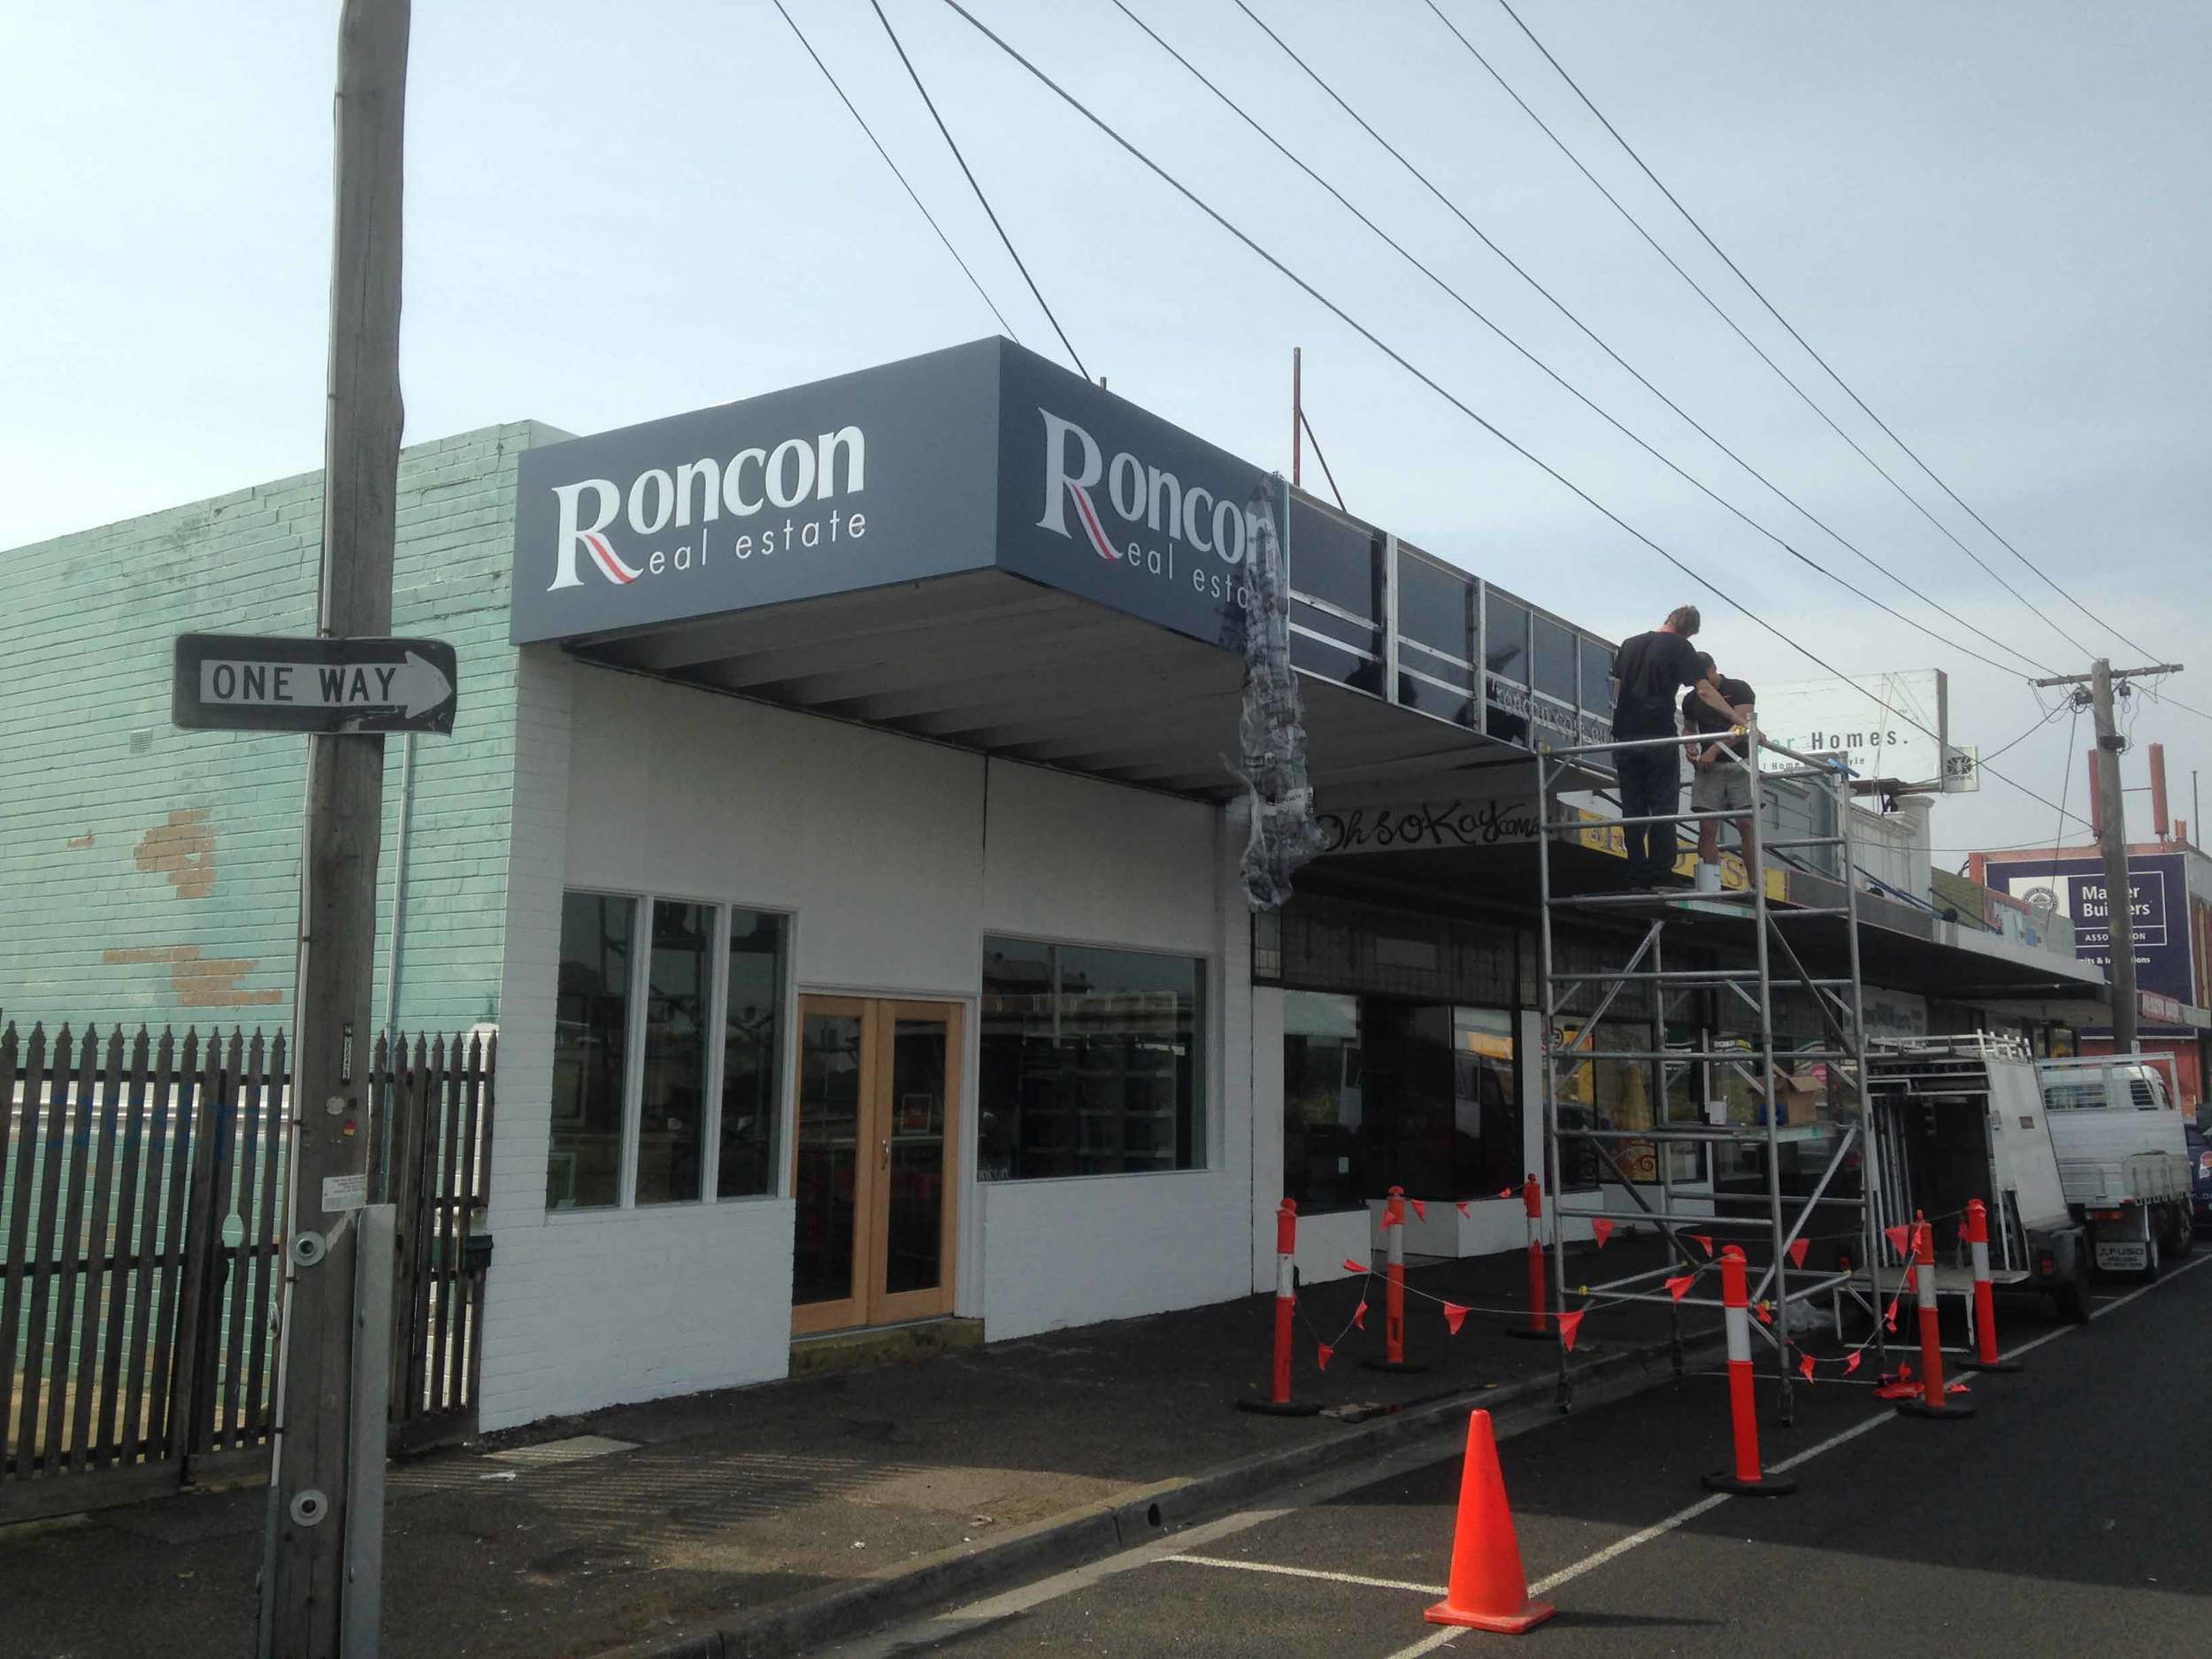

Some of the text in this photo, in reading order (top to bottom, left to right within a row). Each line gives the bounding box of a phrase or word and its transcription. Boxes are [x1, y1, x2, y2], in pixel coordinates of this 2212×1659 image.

[1035, 407, 1273, 564] Roncon
[547, 426, 865, 592] Roncon
[735, 510, 866, 559] estate
[212, 664, 397, 703] ONE WAY
[1811, 730, 1909, 750] Homes.
[2082, 886, 2139, 900] Maer
[2084, 902, 2151, 918] Buiers
